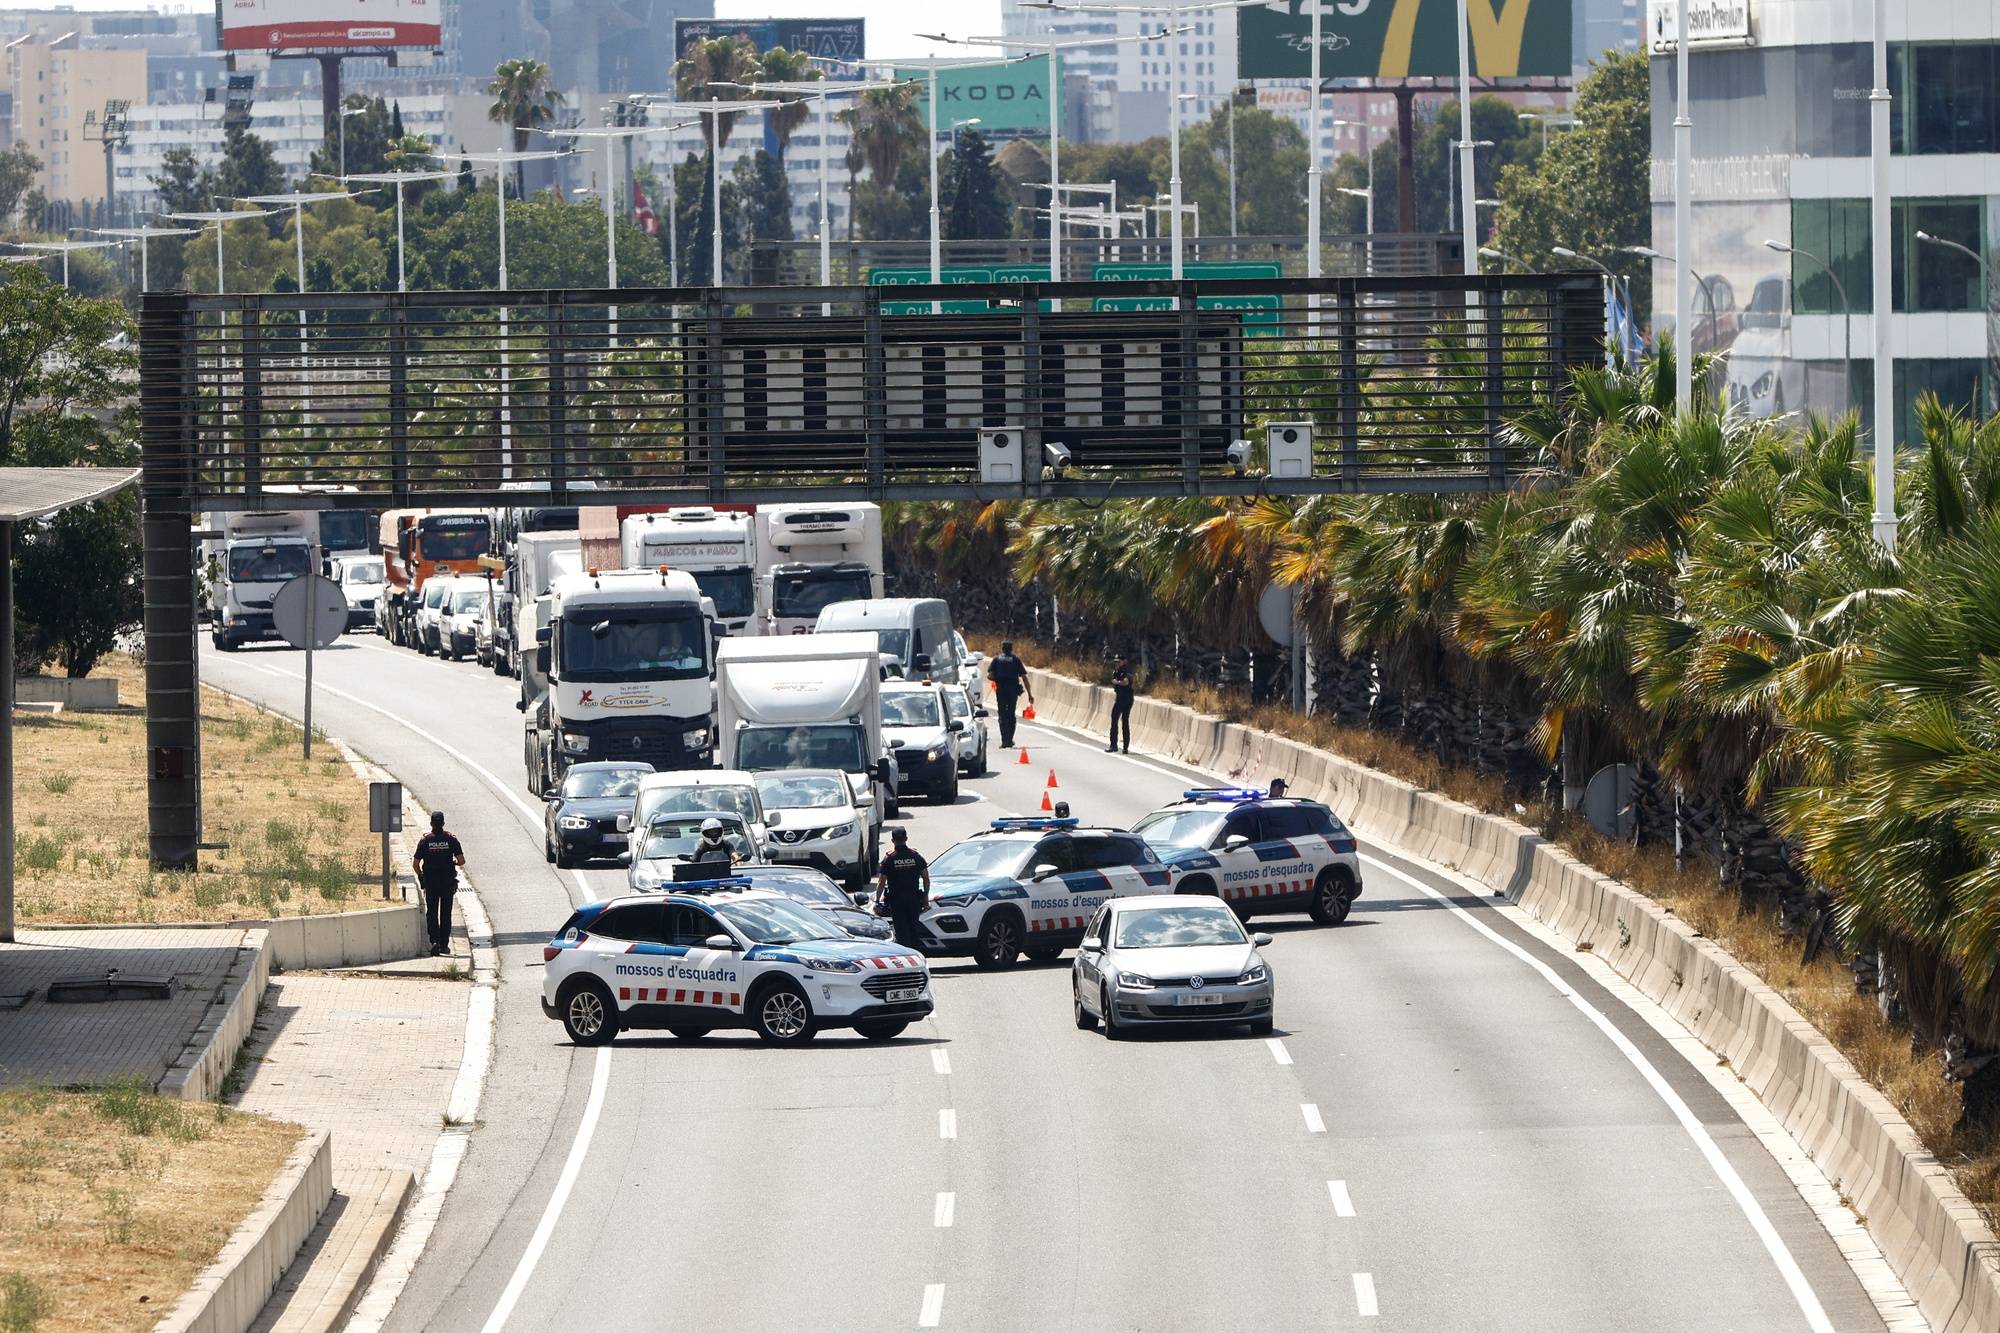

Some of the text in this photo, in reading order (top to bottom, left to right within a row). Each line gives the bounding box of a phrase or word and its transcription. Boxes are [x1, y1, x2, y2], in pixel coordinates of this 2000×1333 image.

[1223, 861, 1314, 882] mossos d'esquadra
[1031, 898, 1069, 909] mossos
[616, 964, 737, 982] mossos d'esquadra
